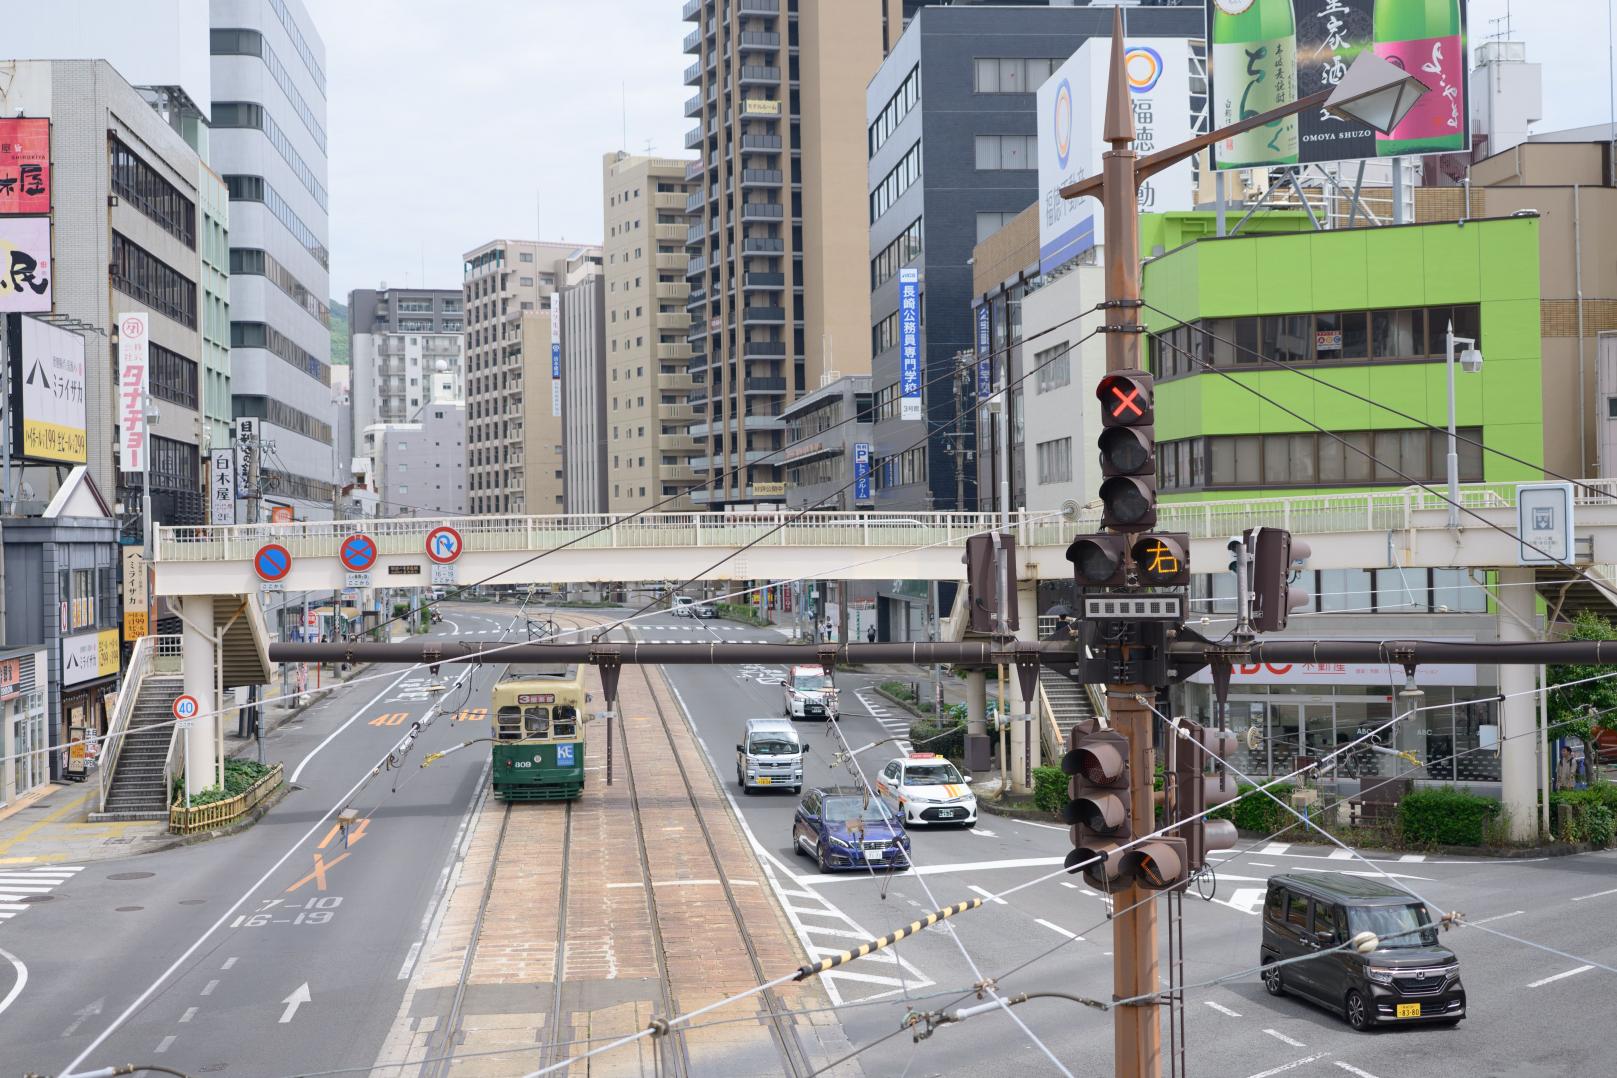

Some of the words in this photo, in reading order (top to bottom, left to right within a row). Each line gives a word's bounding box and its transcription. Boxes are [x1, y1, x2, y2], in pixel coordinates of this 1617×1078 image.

[1302, 133, 1336, 142] OMOYA
[1339, 129, 1372, 138] SHUZO
[1132, 99, 1154, 213] 福徳動
[0, 250, 48, 295] 民
[903, 285, 918, 395] 長崎公務員専門学校
[53, 373, 83, 404] ミライザカ
[123, 365, 144, 467] タナチョー
[857, 450, 866, 459] P
[216, 454, 231, 501] 白木屋
[1147, 541, 1177, 573] 右
[128, 561, 136, 605] ミライザカ
[179, 702, 193, 714] 40
[368, 712, 409, 727] 40
[229, 911, 334, 928] 16-19
